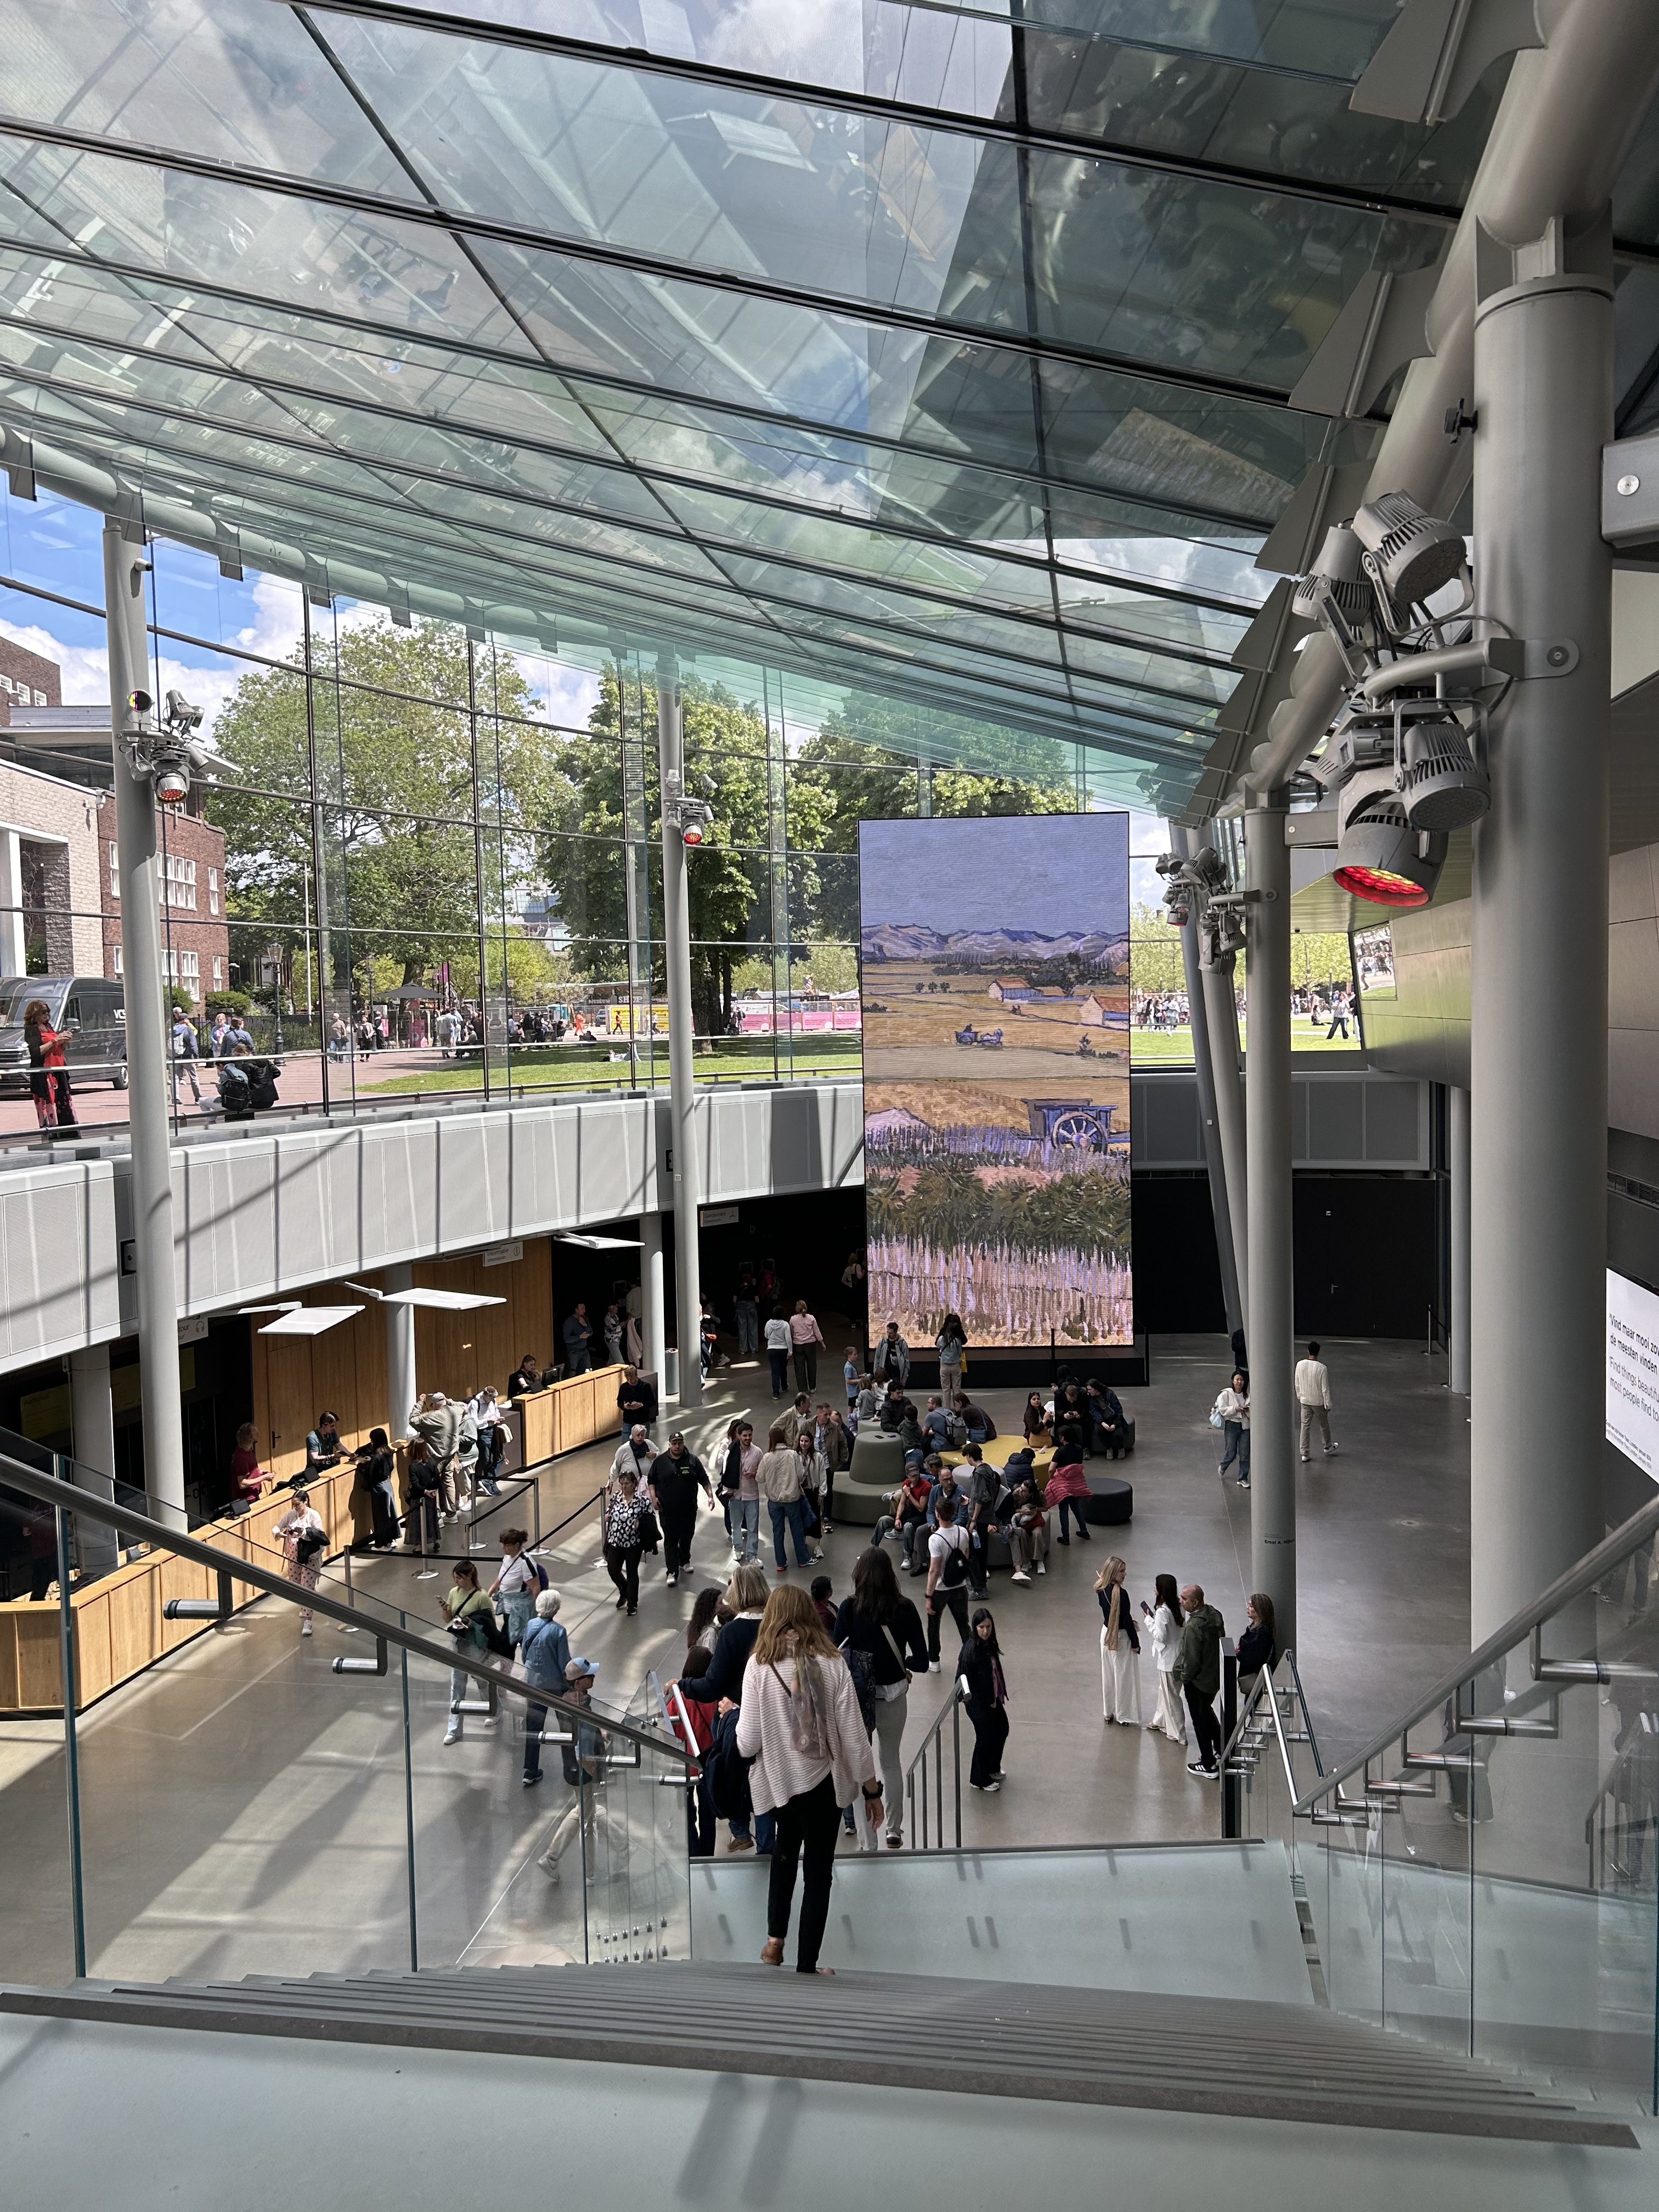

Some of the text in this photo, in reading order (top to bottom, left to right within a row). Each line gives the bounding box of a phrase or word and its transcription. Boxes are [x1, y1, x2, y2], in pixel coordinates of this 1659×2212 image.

[1622, 1324, 1635, 1339] maar
[1636, 1333, 1649, 1350] mooi
[1610, 1333, 1657, 1375] de meesten vinden
[1622, 1365, 1637, 1386] things
[1610, 1377, 1622, 1394] most
[1623, 1387, 1640, 1408] people
[1641, 1397, 1651, 1417] find
